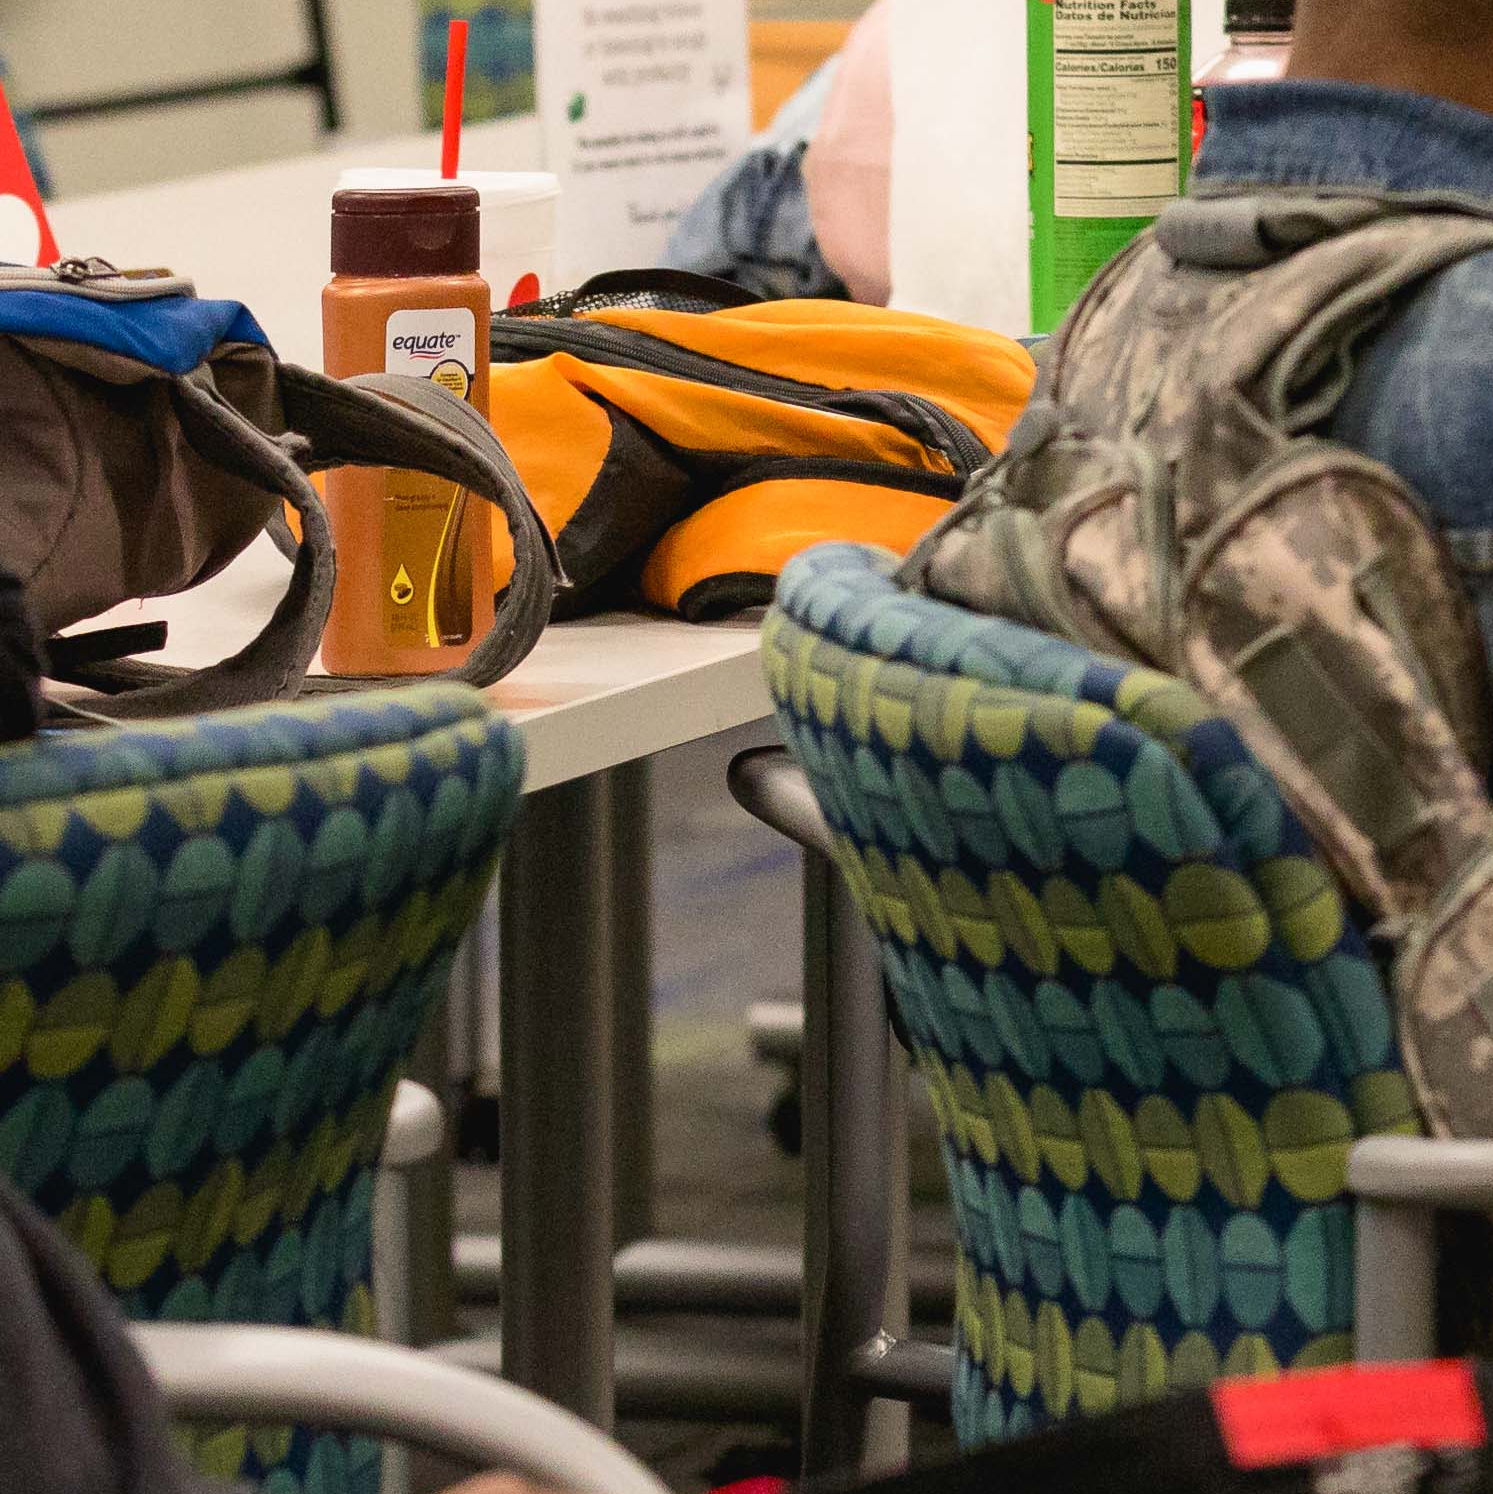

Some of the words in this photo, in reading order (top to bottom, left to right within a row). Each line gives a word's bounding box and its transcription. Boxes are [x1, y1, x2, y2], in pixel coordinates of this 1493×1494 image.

[1120, 0, 1157, 10] Facts
[1055, 10, 1093, 21] Datos
[1097, 10, 1115, 21] de
[1156, 56, 1177, 70] 150
